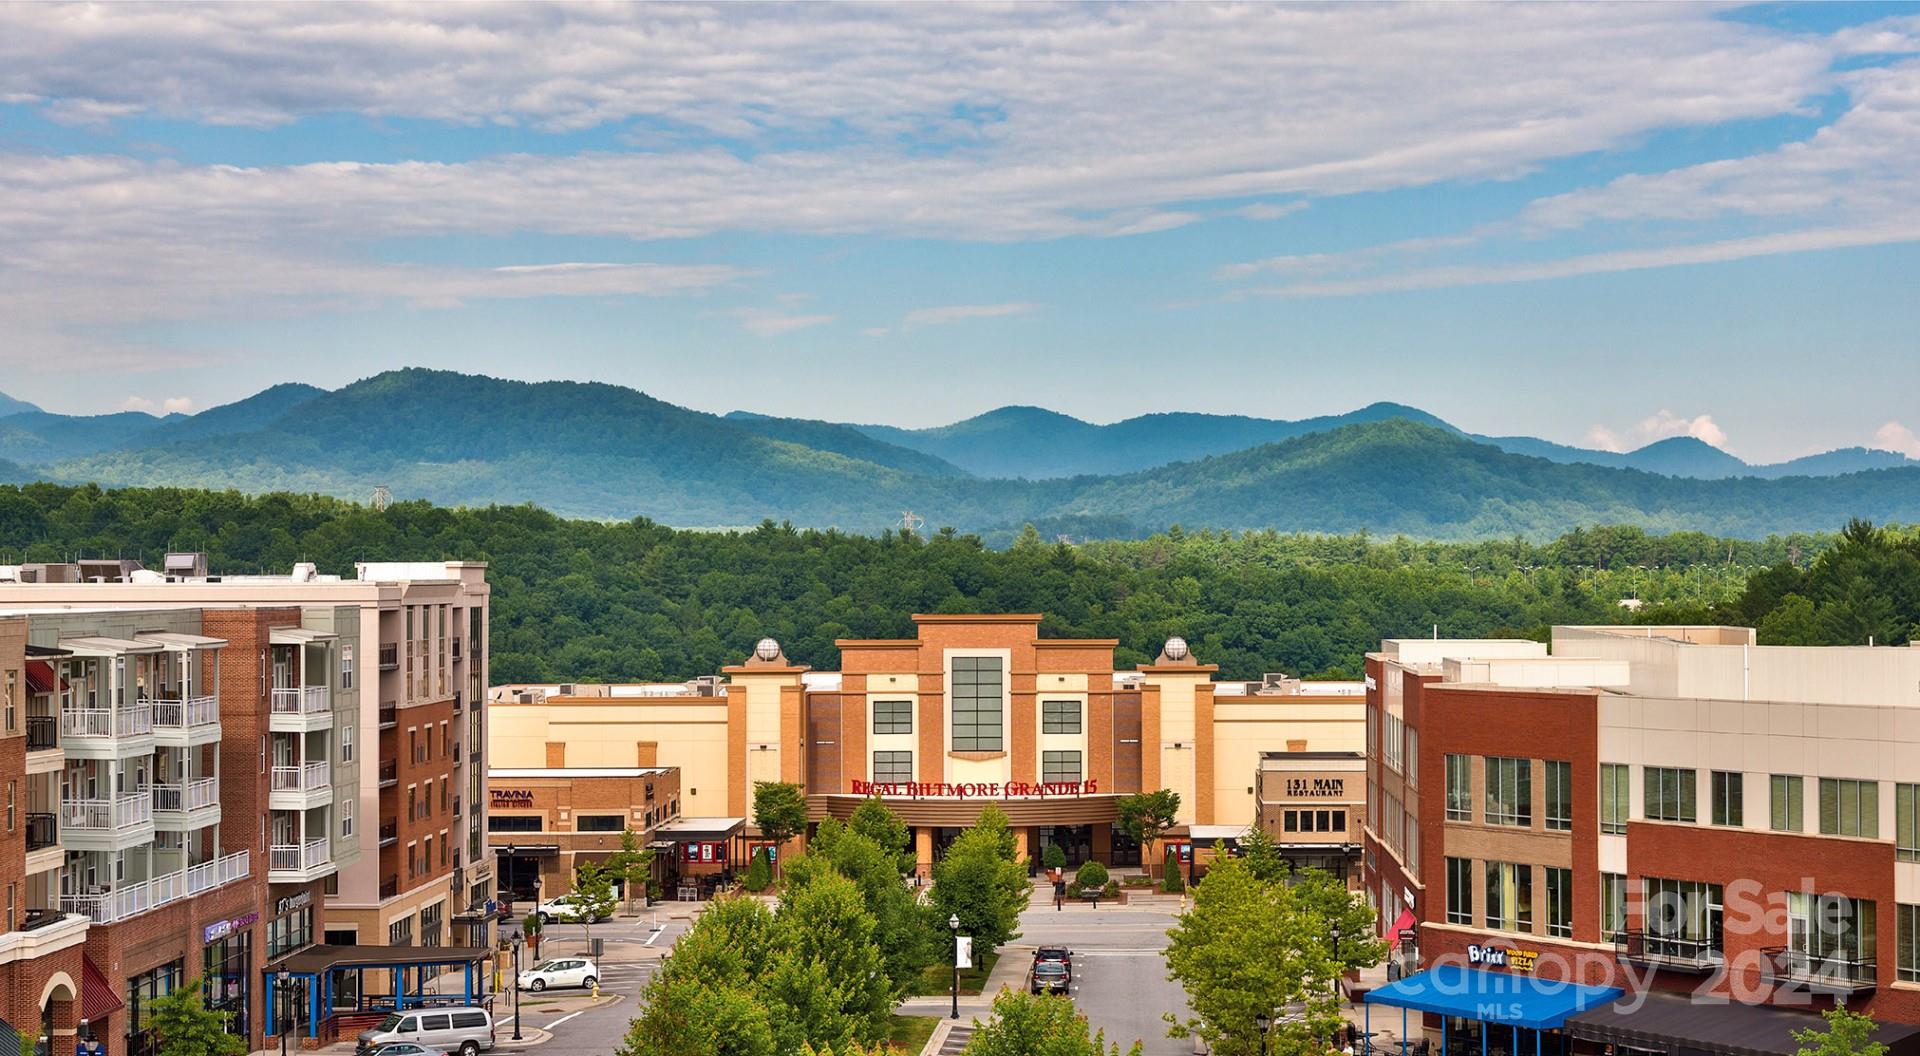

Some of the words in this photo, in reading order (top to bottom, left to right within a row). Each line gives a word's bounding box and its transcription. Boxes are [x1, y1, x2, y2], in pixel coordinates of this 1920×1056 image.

[852, 780, 902, 796] REGAL
[903, 781, 1000, 797] BILTMORE
[1004, 781, 1080, 796] GRANDE
[1083, 779, 1098, 794] 15
[1287, 779, 1307, 790] 131
[1313, 779, 1344, 790] MAIN
[490, 790, 534, 800] TRAVINIA
[1467, 945, 1504, 964] Brixx
